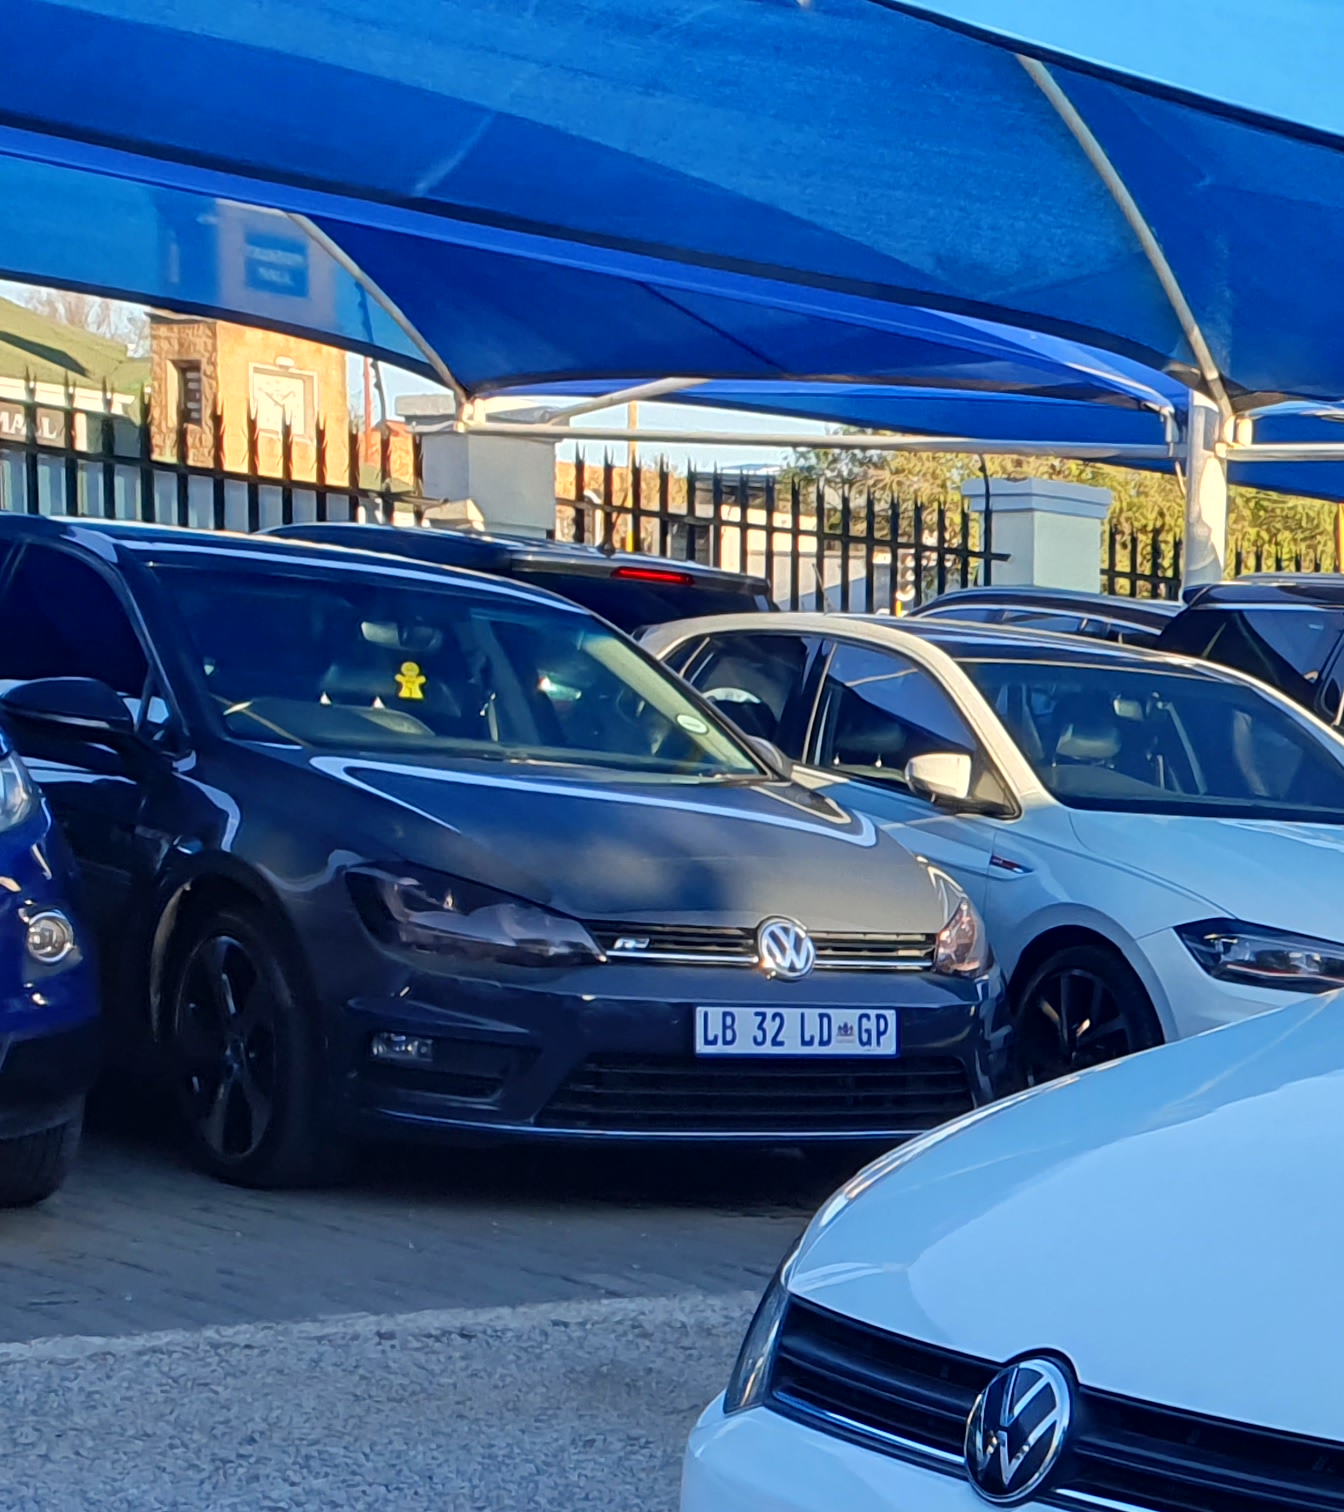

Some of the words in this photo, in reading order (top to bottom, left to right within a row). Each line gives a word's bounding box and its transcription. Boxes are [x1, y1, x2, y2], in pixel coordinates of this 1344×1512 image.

[703, 1010, 737, 1046] LB
[752, 1011, 785, 1047] 32
[800, 1012, 833, 1047] LD
[857, 1012, 889, 1048] GP
